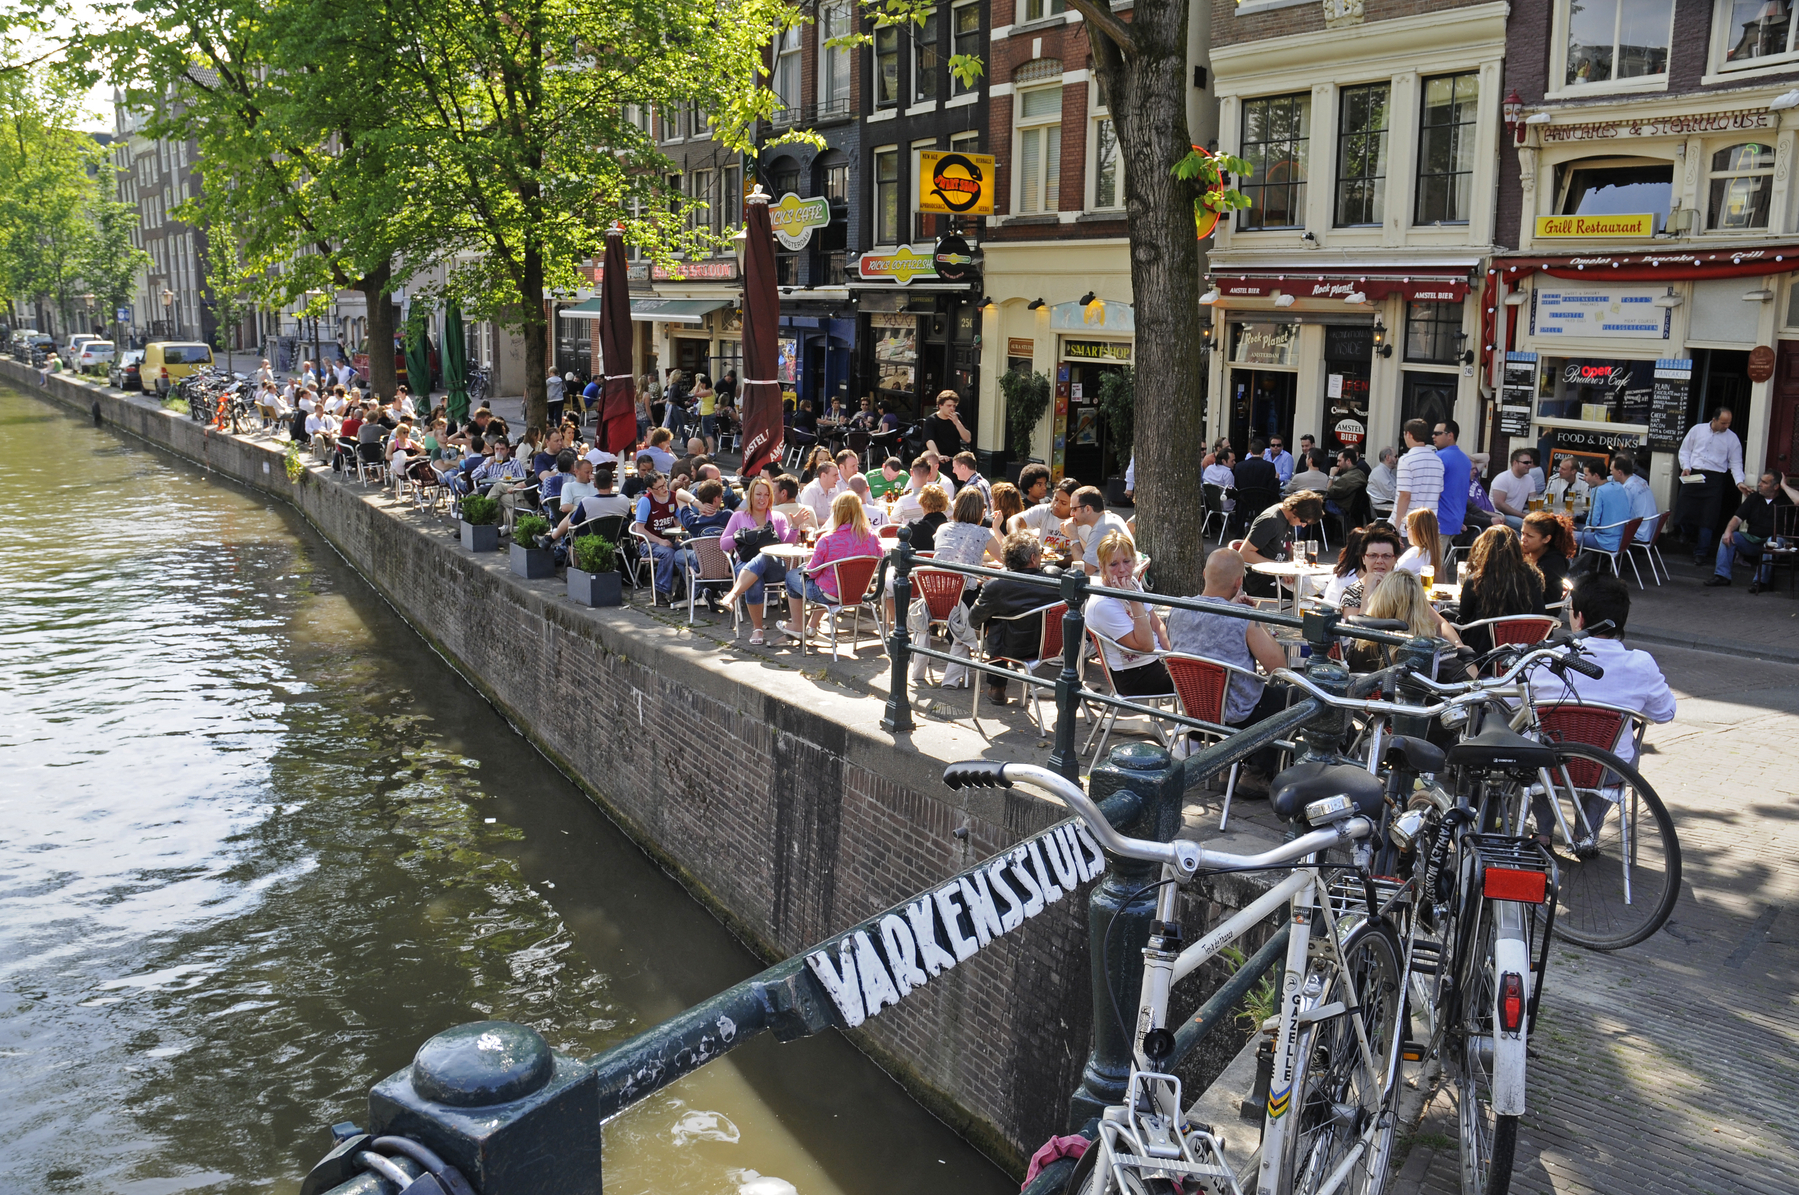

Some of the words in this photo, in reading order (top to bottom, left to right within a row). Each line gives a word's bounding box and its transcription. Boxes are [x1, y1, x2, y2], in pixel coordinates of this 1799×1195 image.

[1543, 122, 1619, 142] PANCAKES
[1629, 121, 1641, 136] &
[1651, 111, 1768, 136] STEAKHOUSE
[934, 174, 959, 190] SMART
[959, 180, 979, 194] SHOP
[1544, 219, 1572, 234] Grill
[1576, 218, 1643, 234] Restaurant
[780, 231, 810, 249] AMSTERDAM
[891, 258, 935, 271] COFFEESHO
[1570, 257, 1611, 265] Omelet
[1641, 254, 1695, 263] Pancake
[1730, 250, 1764, 260] Grill
[689, 264, 731, 278] SALOON
[1229, 286, 1247, 294] AMSTEL
[1248, 287, 1260, 295] BIER
[1311, 283, 1330, 296] Rock
[1414, 291, 1437, 300] AMSTEL
[1438, 292, 1454, 300] BIER
[1245, 332, 1262, 345] Rock
[1262, 331, 1289, 349] Planet
[1070, 344, 1131, 360] SMARTSHOP
[1562, 364, 1604, 385] Bredero's
[1581, 365, 1612, 378] Open
[1655, 370, 1688, 378] PANCAKES
[1341, 379, 1369, 391] OPEN
[1654, 383, 1671, 391] PLAIN
[1336, 423, 1362, 433] AMSTEL
[1341, 433, 1358, 442] BIER
[1557, 432, 1585, 443] FOOD
[1587, 435, 1596, 445] &
[1599, 436, 1639, 449] DRINKS
[804, 818, 1106, 1029] VARKENSSLUIS
[1283, 994, 1301, 1081] GAZELLE
